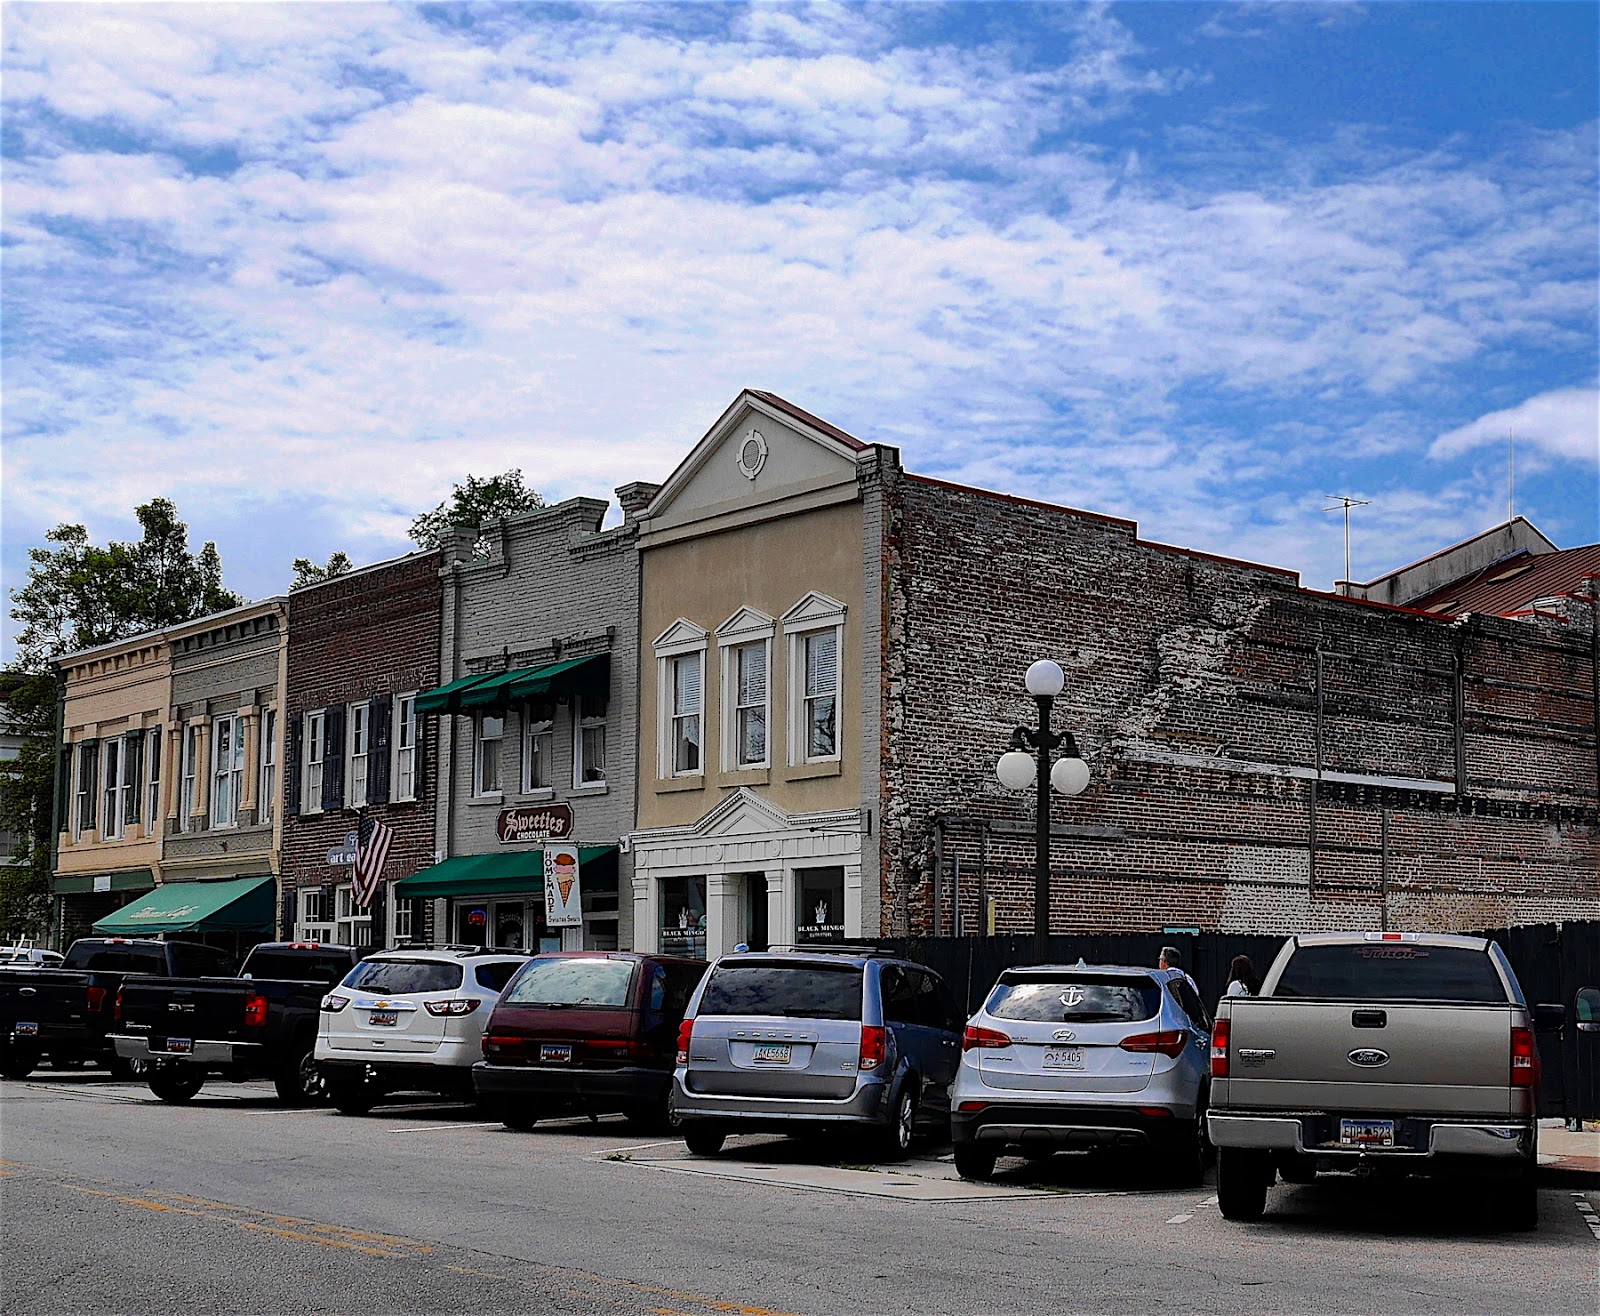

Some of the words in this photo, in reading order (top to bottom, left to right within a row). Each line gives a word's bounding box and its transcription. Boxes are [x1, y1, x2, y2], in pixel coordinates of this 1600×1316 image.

[504, 810, 565, 841] Sweeties
[516, 830, 551, 840] CHOCOLATE
[330, 853, 344, 863] art
[544, 851, 555, 914] HOMEMADE
[1061, 1051, 1081, 1062] 5405
[1357, 1052, 1378, 1062] Ford
